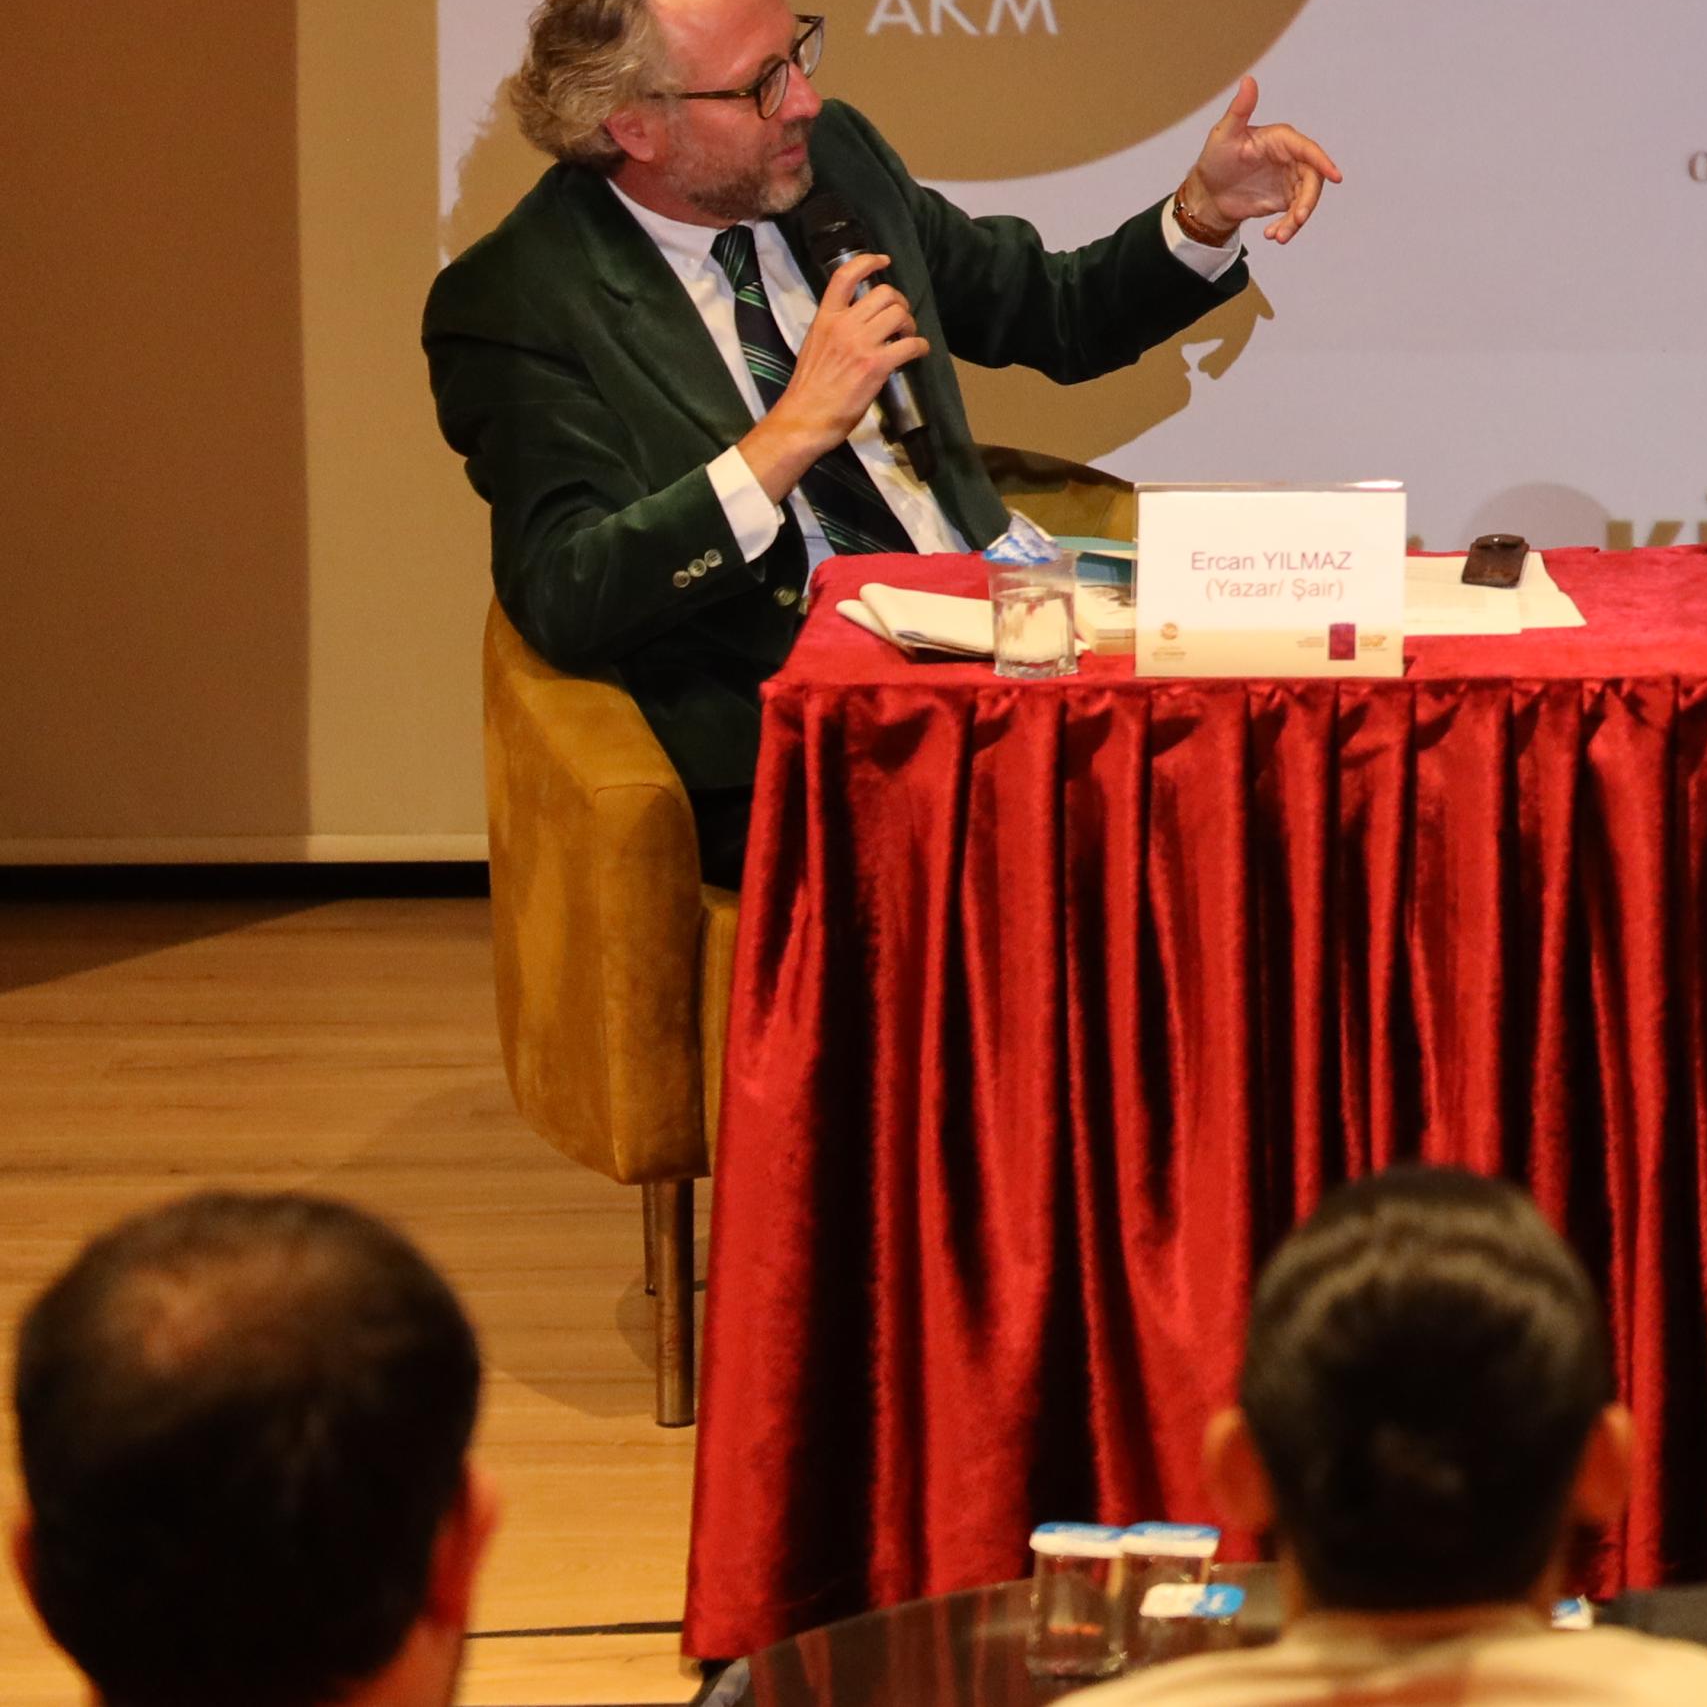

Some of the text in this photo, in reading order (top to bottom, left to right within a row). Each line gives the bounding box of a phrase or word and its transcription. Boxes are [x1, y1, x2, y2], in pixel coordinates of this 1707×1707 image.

[1190, 550, 1353, 571] Ercan YILMAZ
[1291, 578, 1345, 603] Şair)
